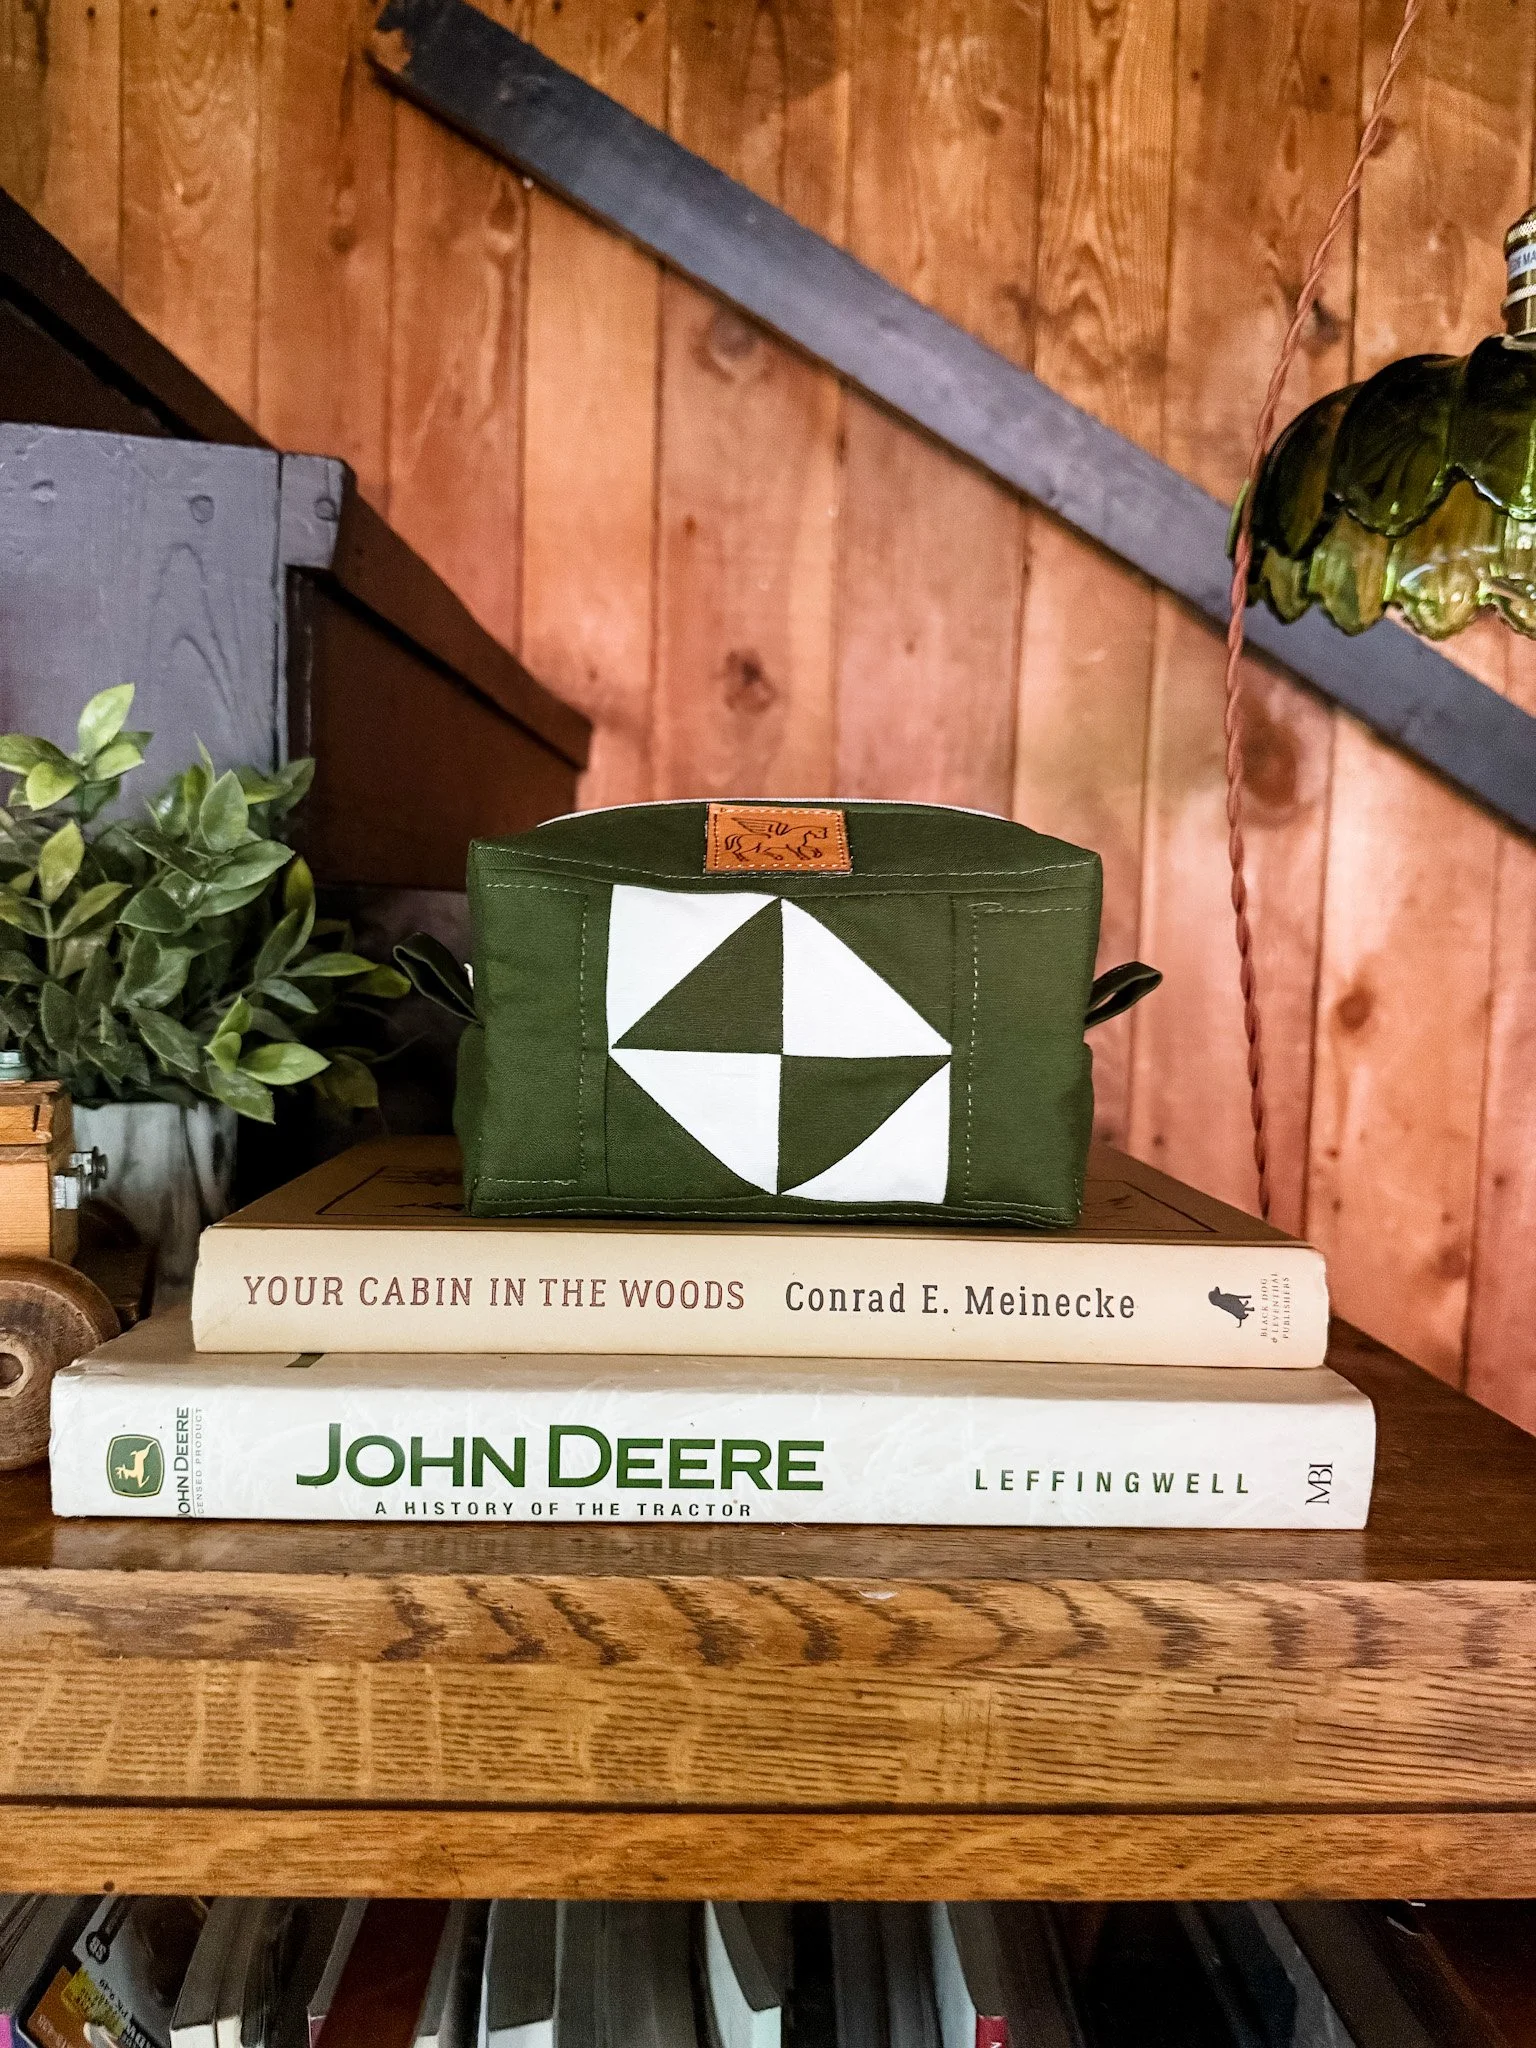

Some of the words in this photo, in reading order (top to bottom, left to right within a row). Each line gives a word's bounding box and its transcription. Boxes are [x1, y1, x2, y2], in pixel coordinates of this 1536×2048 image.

[244, 1275, 343, 1306] YOUR
[360, 1276, 472, 1306] CABIN
[490, 1277, 526, 1307] IN
[539, 1278, 606, 1308] THE
[619, 1279, 745, 1310] WOODS
[785, 1281, 906, 1313] Conrad
[922, 1284, 949, 1315] E.
[965, 1285, 1135, 1319] Meinecke
[1260, 1278, 1268, 1301] DOG
[1282, 1277, 1291, 1339] PUBLISHERS
[1260, 1306, 1269, 1337] BLACK
[174, 1407, 189, 1472] DEERE
[195, 1407, 203, 1464] PRODUCT
[296, 1422, 527, 1489] JOHN
[548, 1423, 824, 1492] DEERE
[975, 1468, 1249, 1495] LEFFINGWELL
[1304, 1462, 1334, 1506] MBI
[375, 1501, 387, 1515] A
[404, 1501, 514, 1516] HISTORY
[530, 1502, 559, 1516] OF
[576, 1502, 621, 1517] THE
[637, 1503, 752, 1518] TRACTOR
